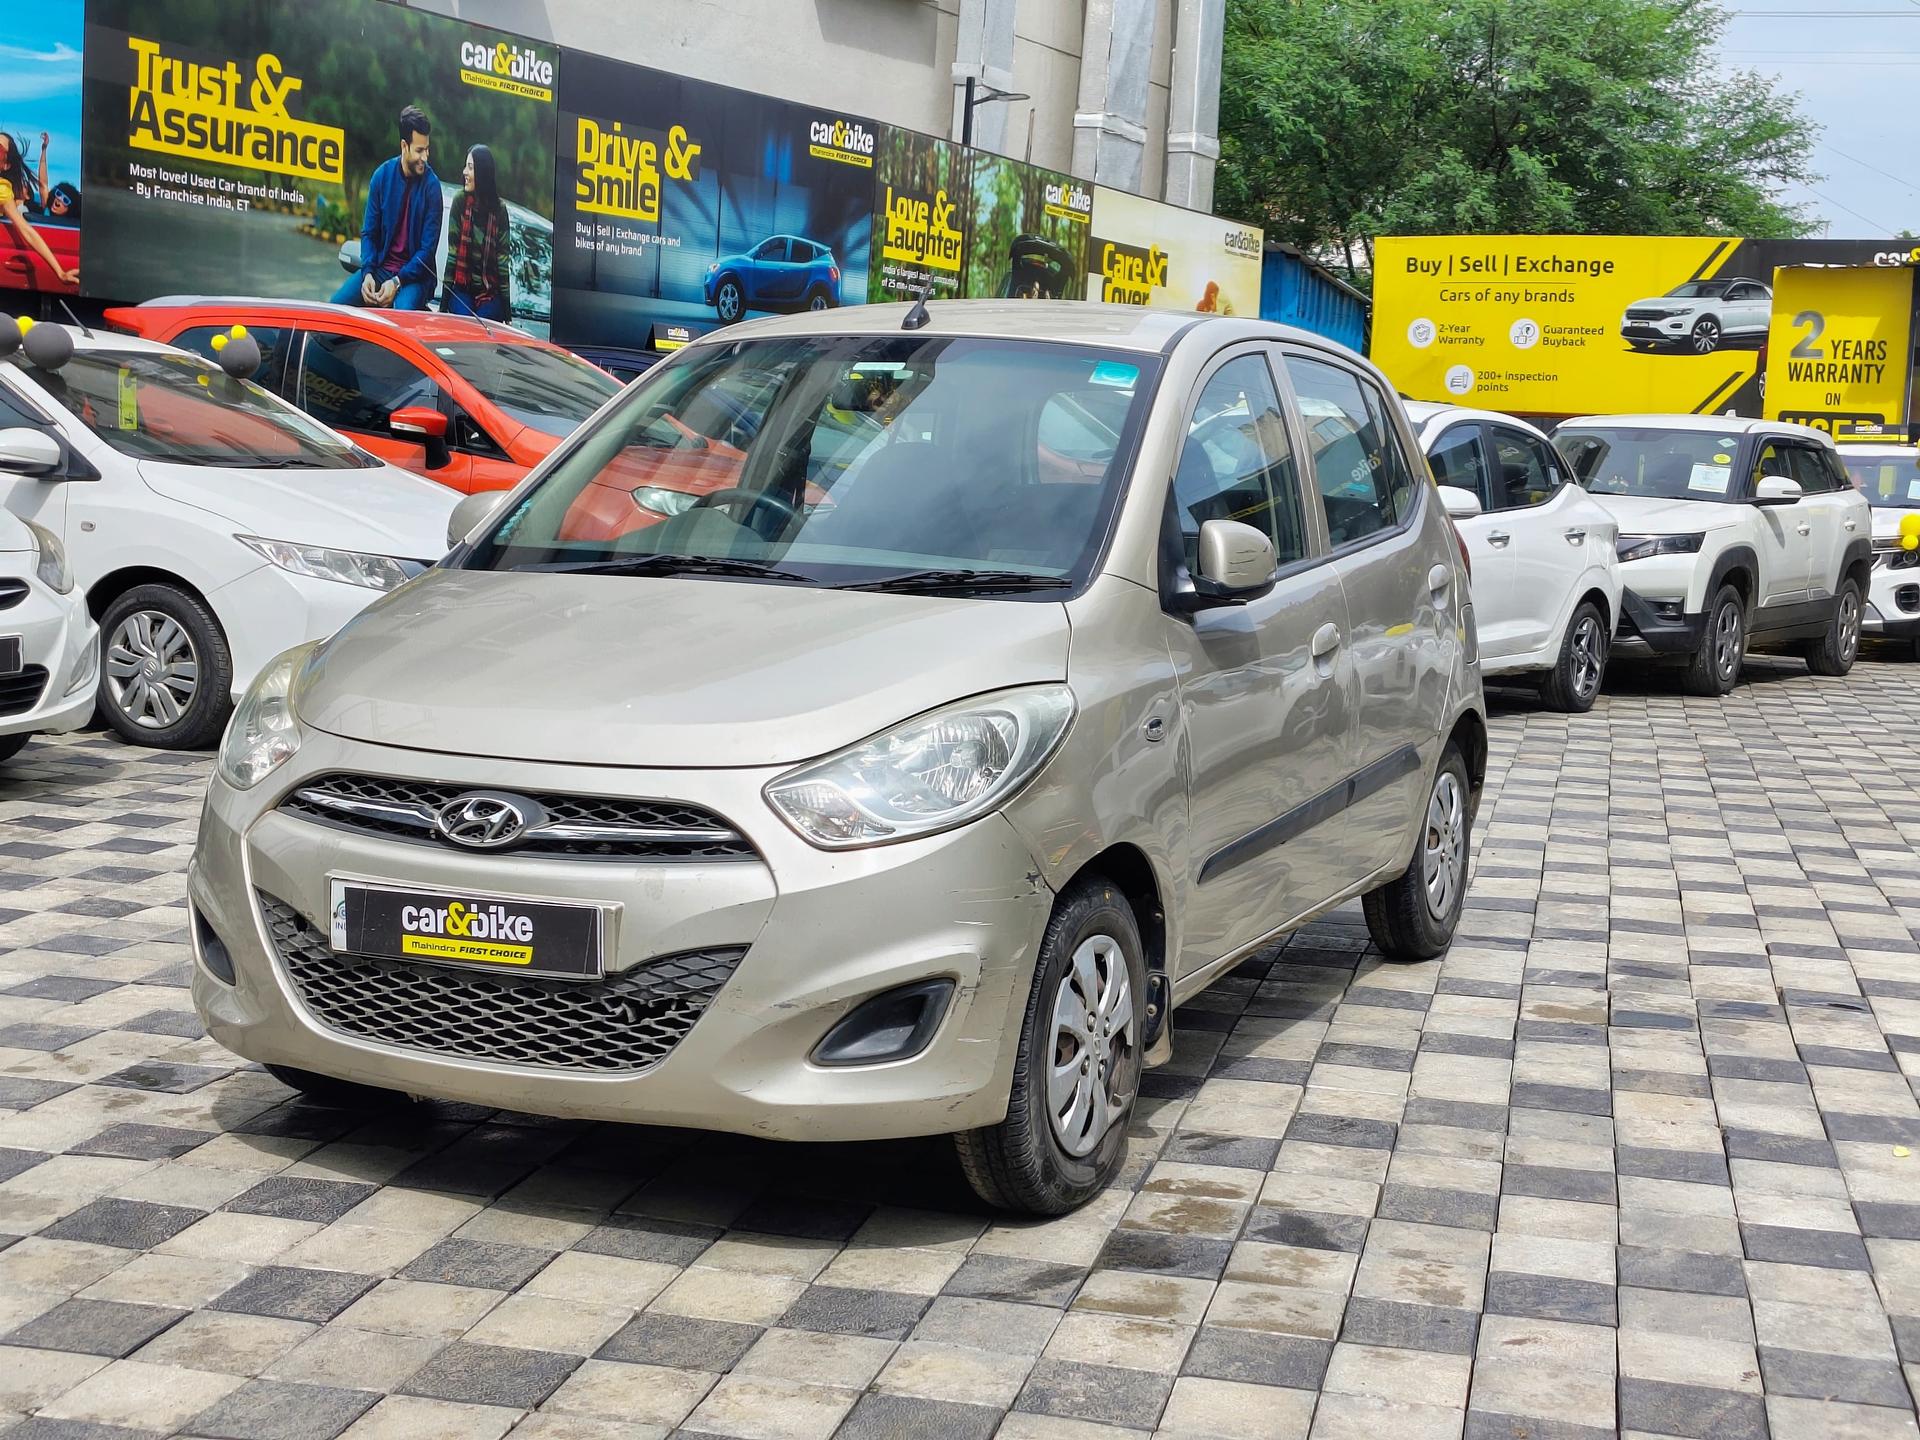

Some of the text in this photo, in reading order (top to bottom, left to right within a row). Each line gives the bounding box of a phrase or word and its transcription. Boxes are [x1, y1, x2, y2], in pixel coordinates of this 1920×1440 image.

[461, 41, 552, 85] car&bike
[129, 37, 302, 118] Trust &
[499, 81, 519, 92] FIRST
[520, 86, 545, 97] CHOICE
[130, 90, 340, 173] Assurance
[810, 120, 873, 153] car&bike
[577, 118, 701, 181] Drive &
[130, 163, 304, 204] Most loved Used Car brand of India
[576, 161, 656, 213] Smile
[136, 184, 151, 198] By
[154, 187, 204, 205] Franchise
[206, 194, 234, 211] India,
[237, 199, 250, 212] ET
[885, 187, 956, 230] Love &
[1045, 183, 1090, 211] car&bike
[576, 222, 591, 236] Buy
[596, 225, 610, 236] Sell
[616, 228, 650, 244] Exchange
[651, 235, 666, 245] cars
[667, 236, 681, 246] and
[884, 217, 960, 261] Laughter
[575, 237, 642, 256] bikes of any brand
[1103, 243, 1168, 287] Care &
[1406, 257, 1442, 276] Buy
[1460, 255, 1497, 272] Sell
[1516, 255, 1615, 276] Exchange
[1439, 288, 1575, 304] Cars of any brands
[1439, 324, 1470, 333] 2-Year
[1543, 325, 1604, 335] Guaranteed
[1790, 310, 1887, 360] 2 YEARS
[1438, 336, 1485, 347] Warranty
[1543, 337, 1585, 348] Buyback
[1477, 371, 1502, 381] 200+
[1788, 362, 1885, 384] WARRANTY
[1477, 383, 1509, 392] points
[1825, 393, 1841, 406] ON
[335, 921, 346, 930] IN
[402, 902, 533, 942] car&bike
[411, 941, 527, 958] Mahindra FIRST CHOICE
